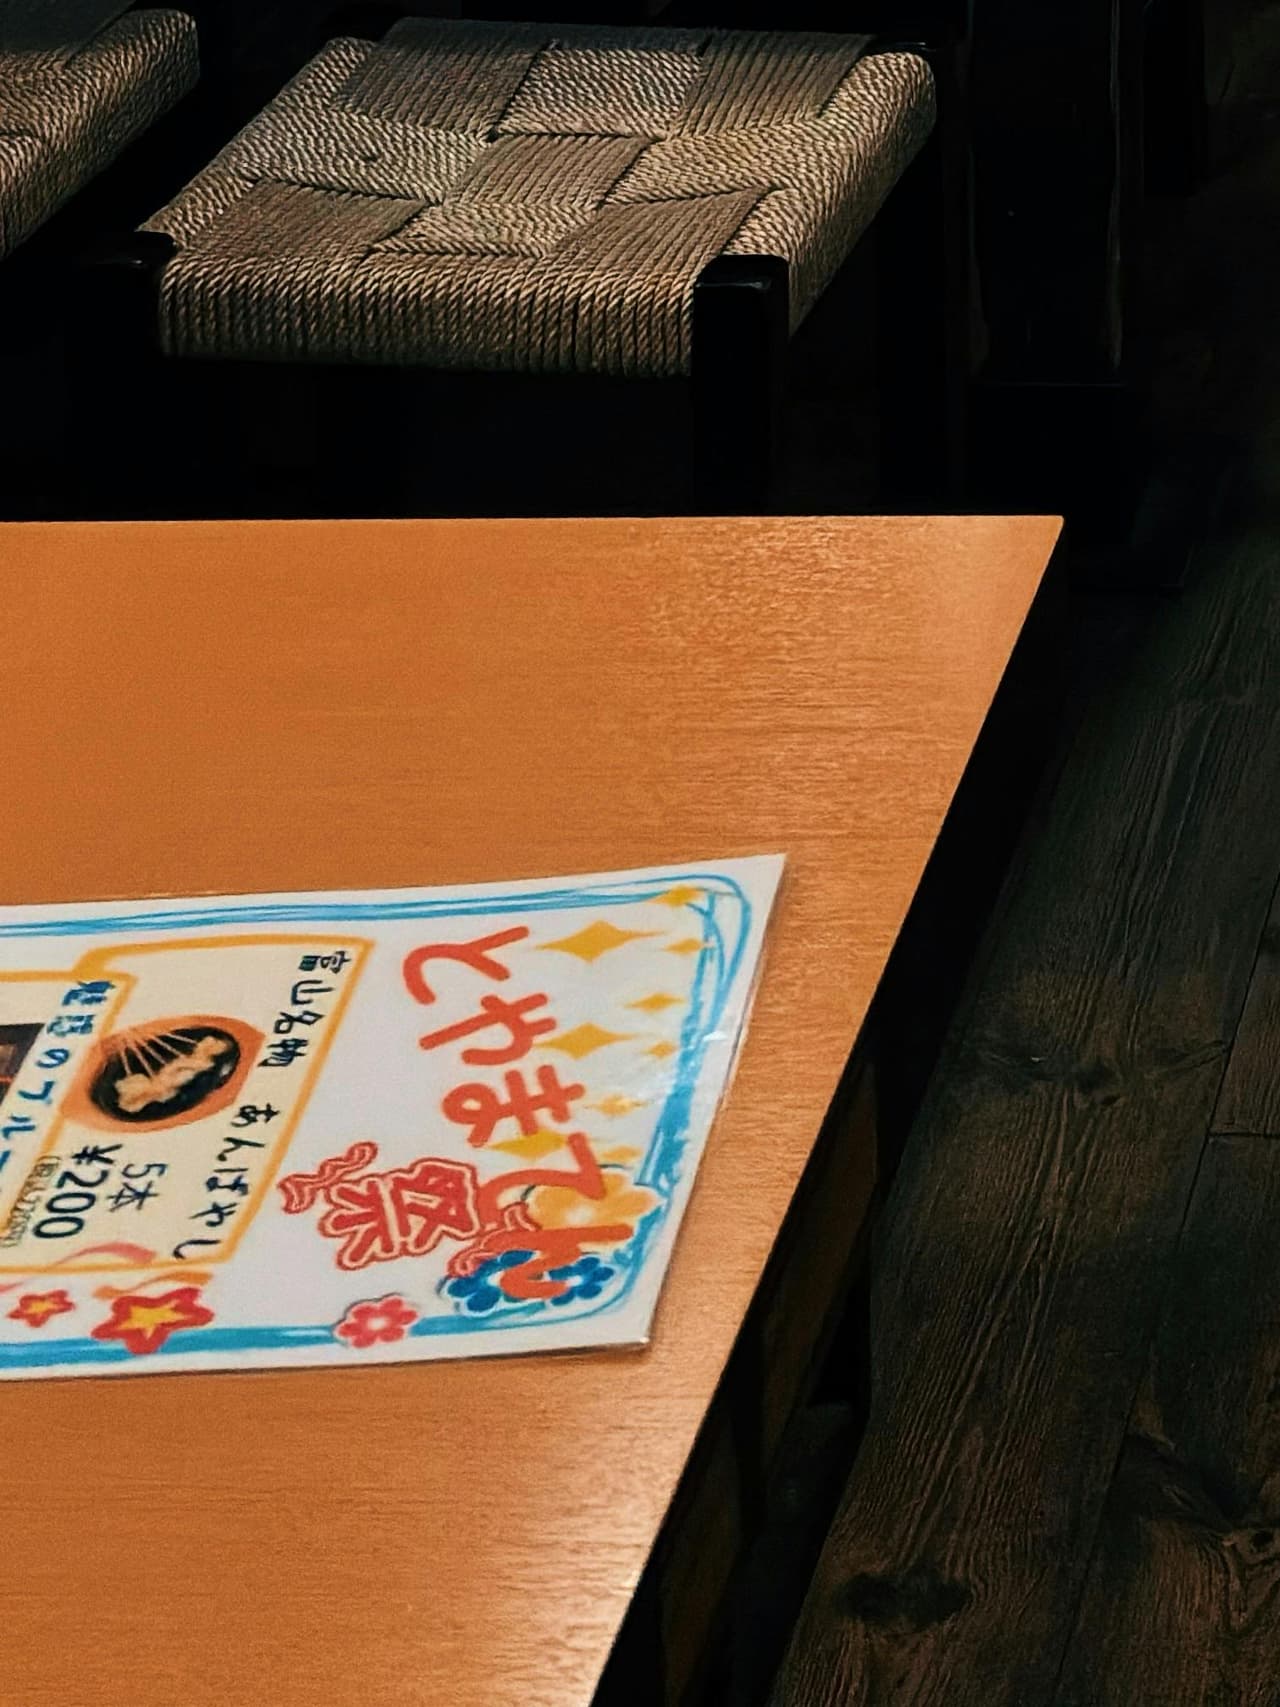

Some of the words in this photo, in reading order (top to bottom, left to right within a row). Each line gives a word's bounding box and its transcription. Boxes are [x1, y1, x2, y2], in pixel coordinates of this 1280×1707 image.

[258, 950, 352, 1068] 富山名物
[33, 1144, 123, 1239] ¥200
[172, 1102, 279, 1260] あんばやし
